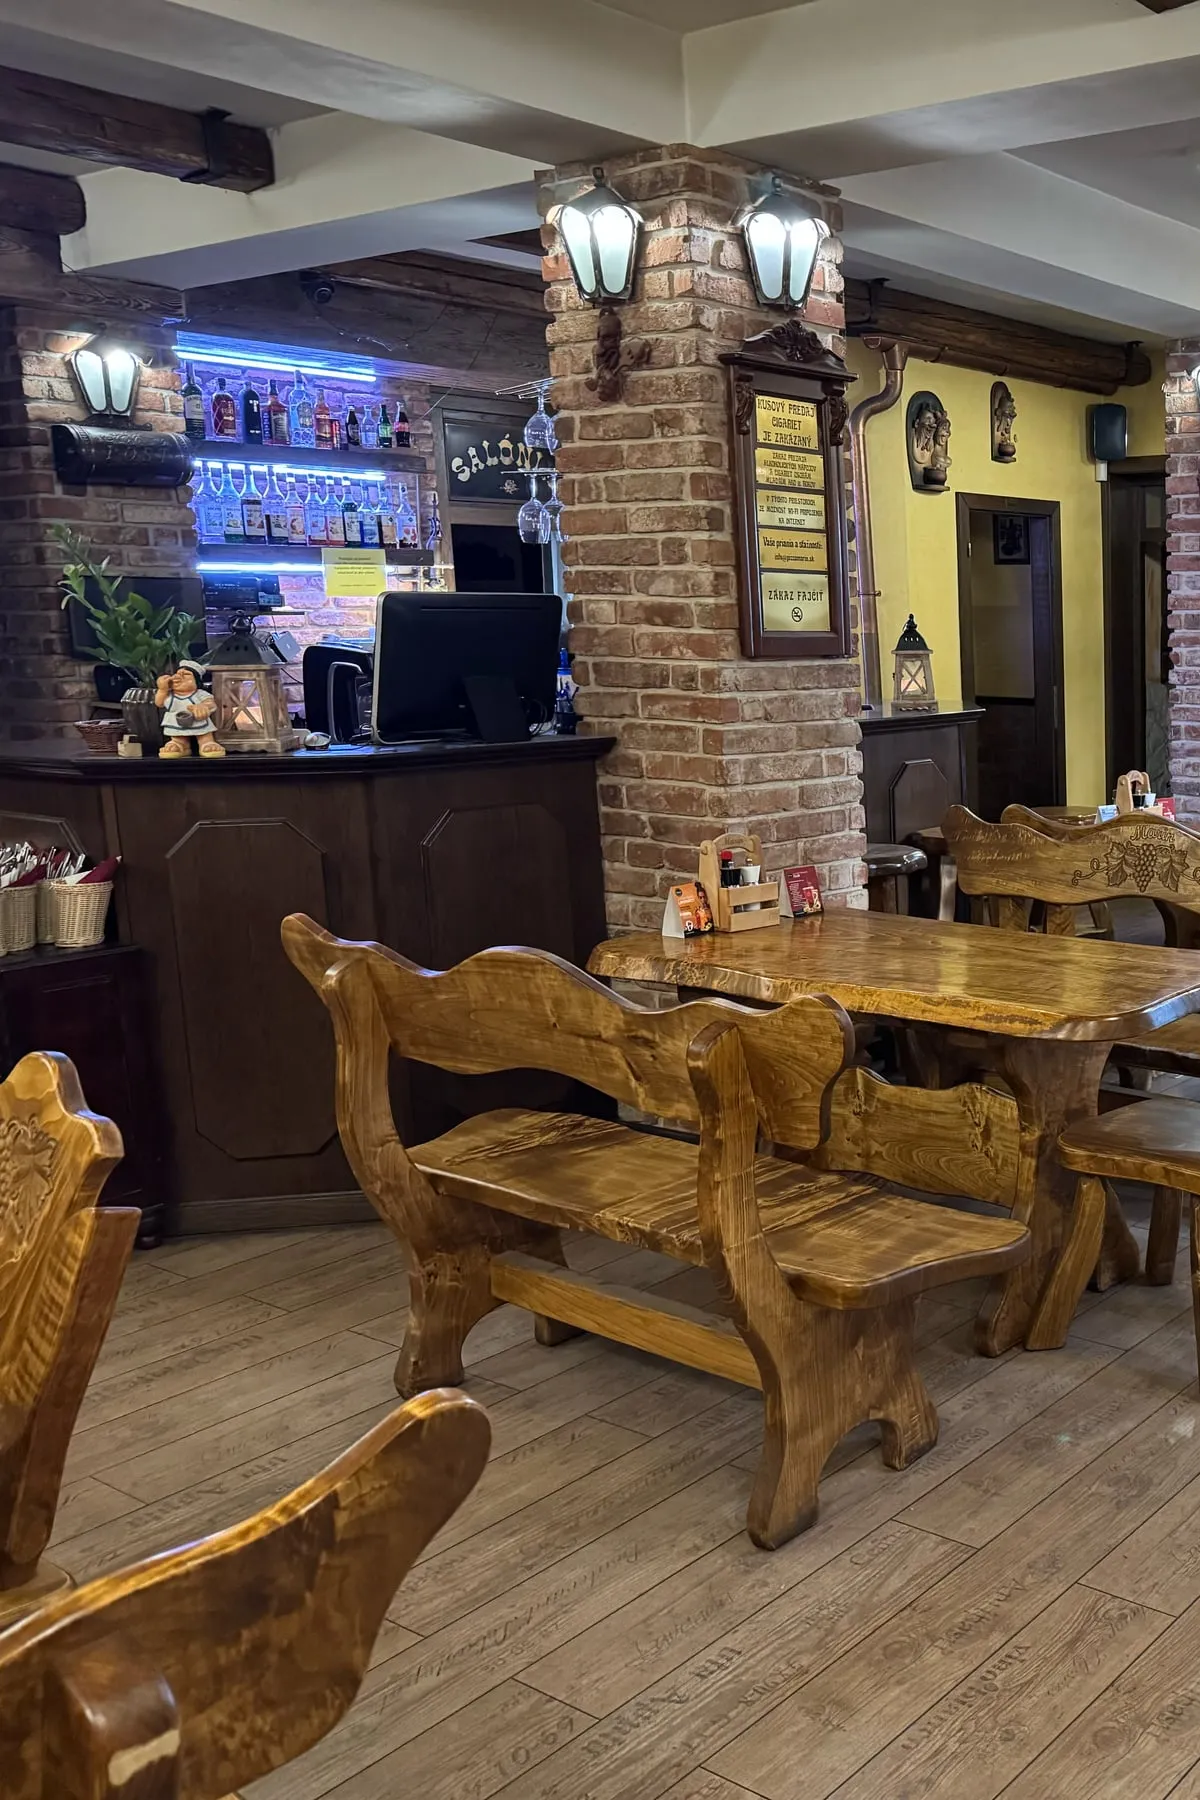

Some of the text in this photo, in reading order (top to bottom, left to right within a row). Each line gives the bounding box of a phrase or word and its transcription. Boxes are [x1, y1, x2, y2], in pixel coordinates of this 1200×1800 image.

[757, 398, 815, 417] KUSOVÝ PREDAJ
[772, 416, 802, 430] CIGARIET
[763, 431, 812, 447] JE ZAKÁZANÝ
[768, 588, 824, 602] ZÁKAZ FAJČIŤ
